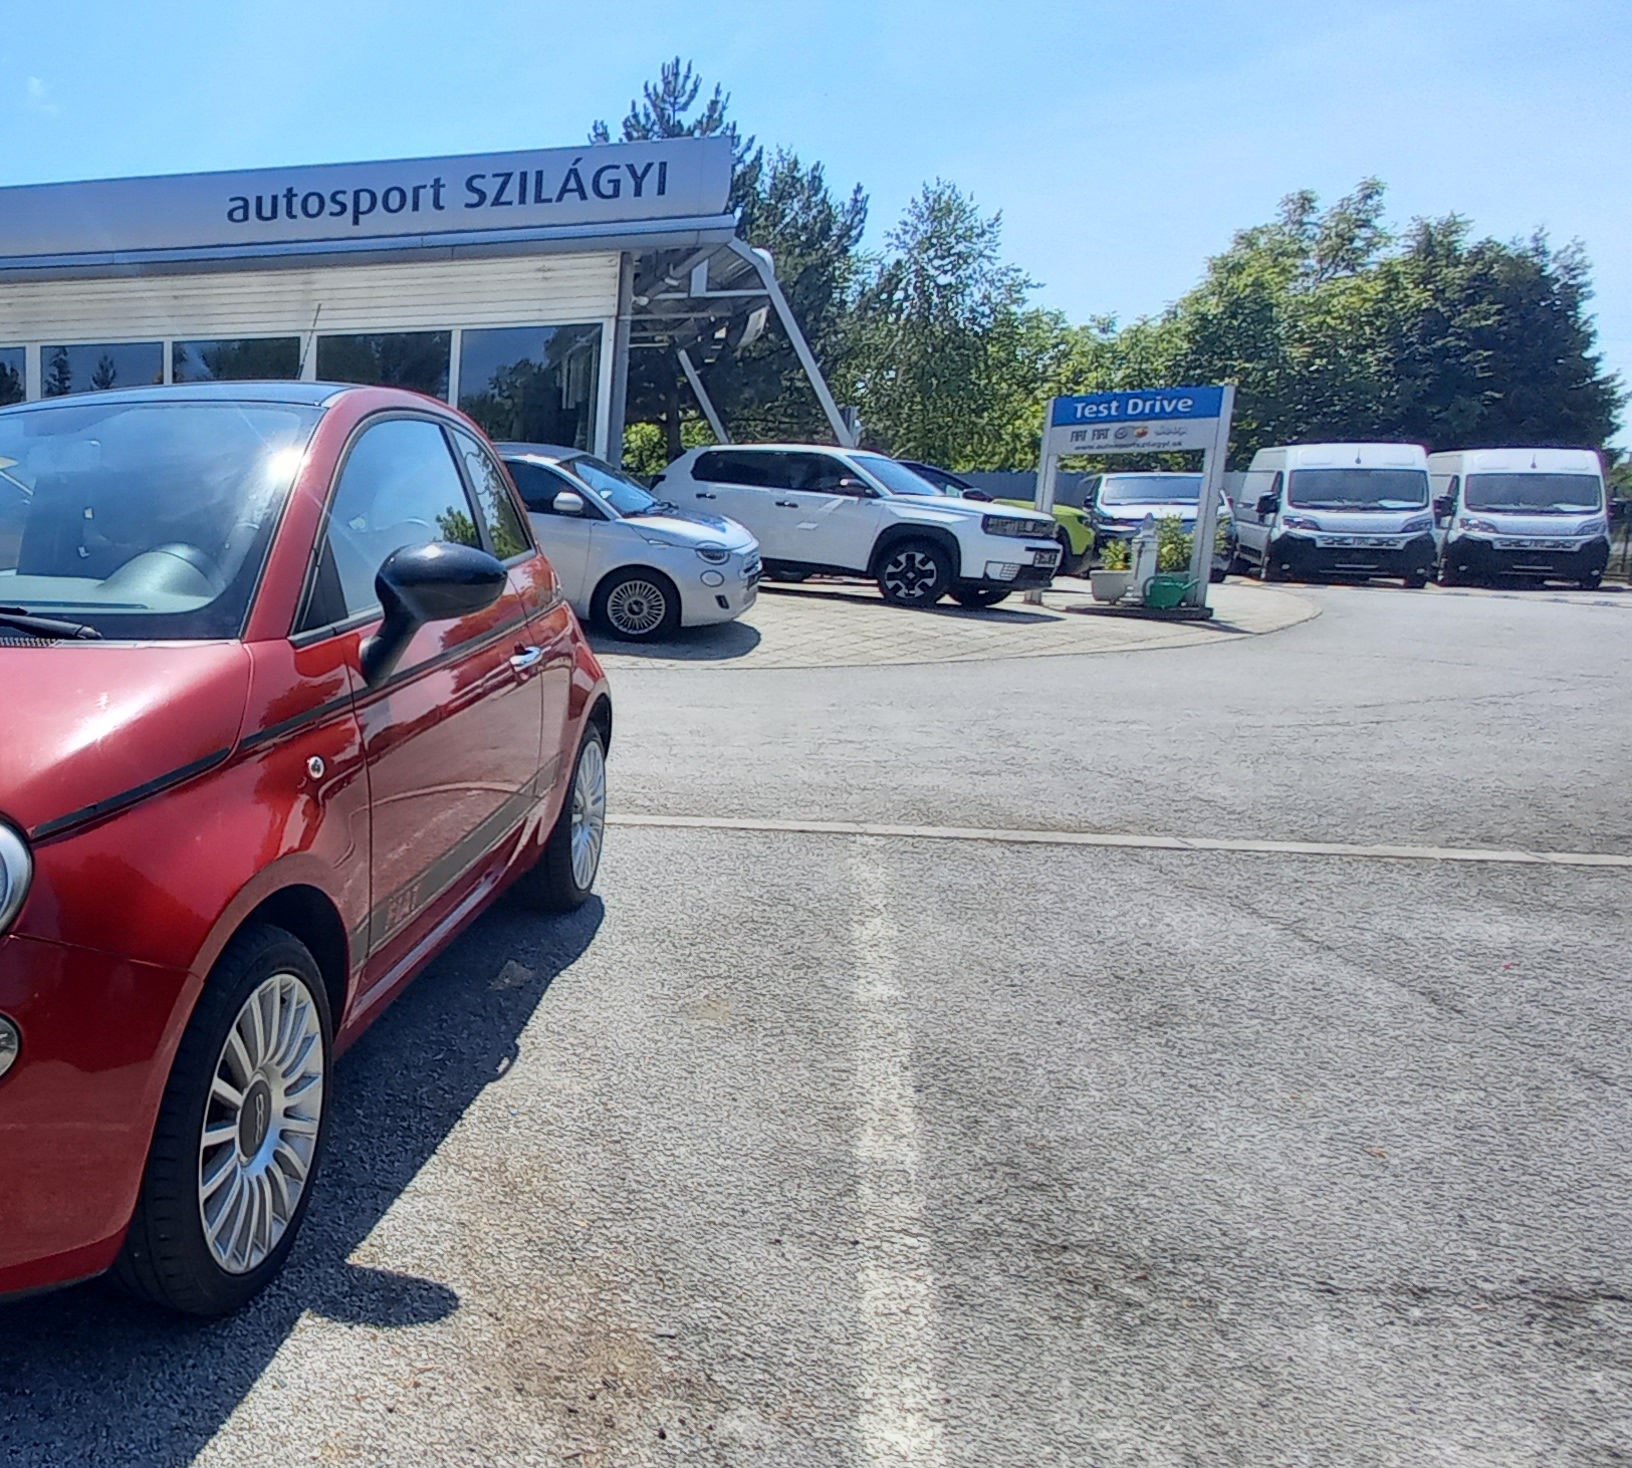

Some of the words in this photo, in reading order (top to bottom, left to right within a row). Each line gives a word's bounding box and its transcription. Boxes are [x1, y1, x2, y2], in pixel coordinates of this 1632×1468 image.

[226, 176, 447, 226] autosport
[463, 157, 668, 209] SZILÁGYI
[1074, 400, 1119, 419] Test
[1126, 395, 1194, 415] Drive
